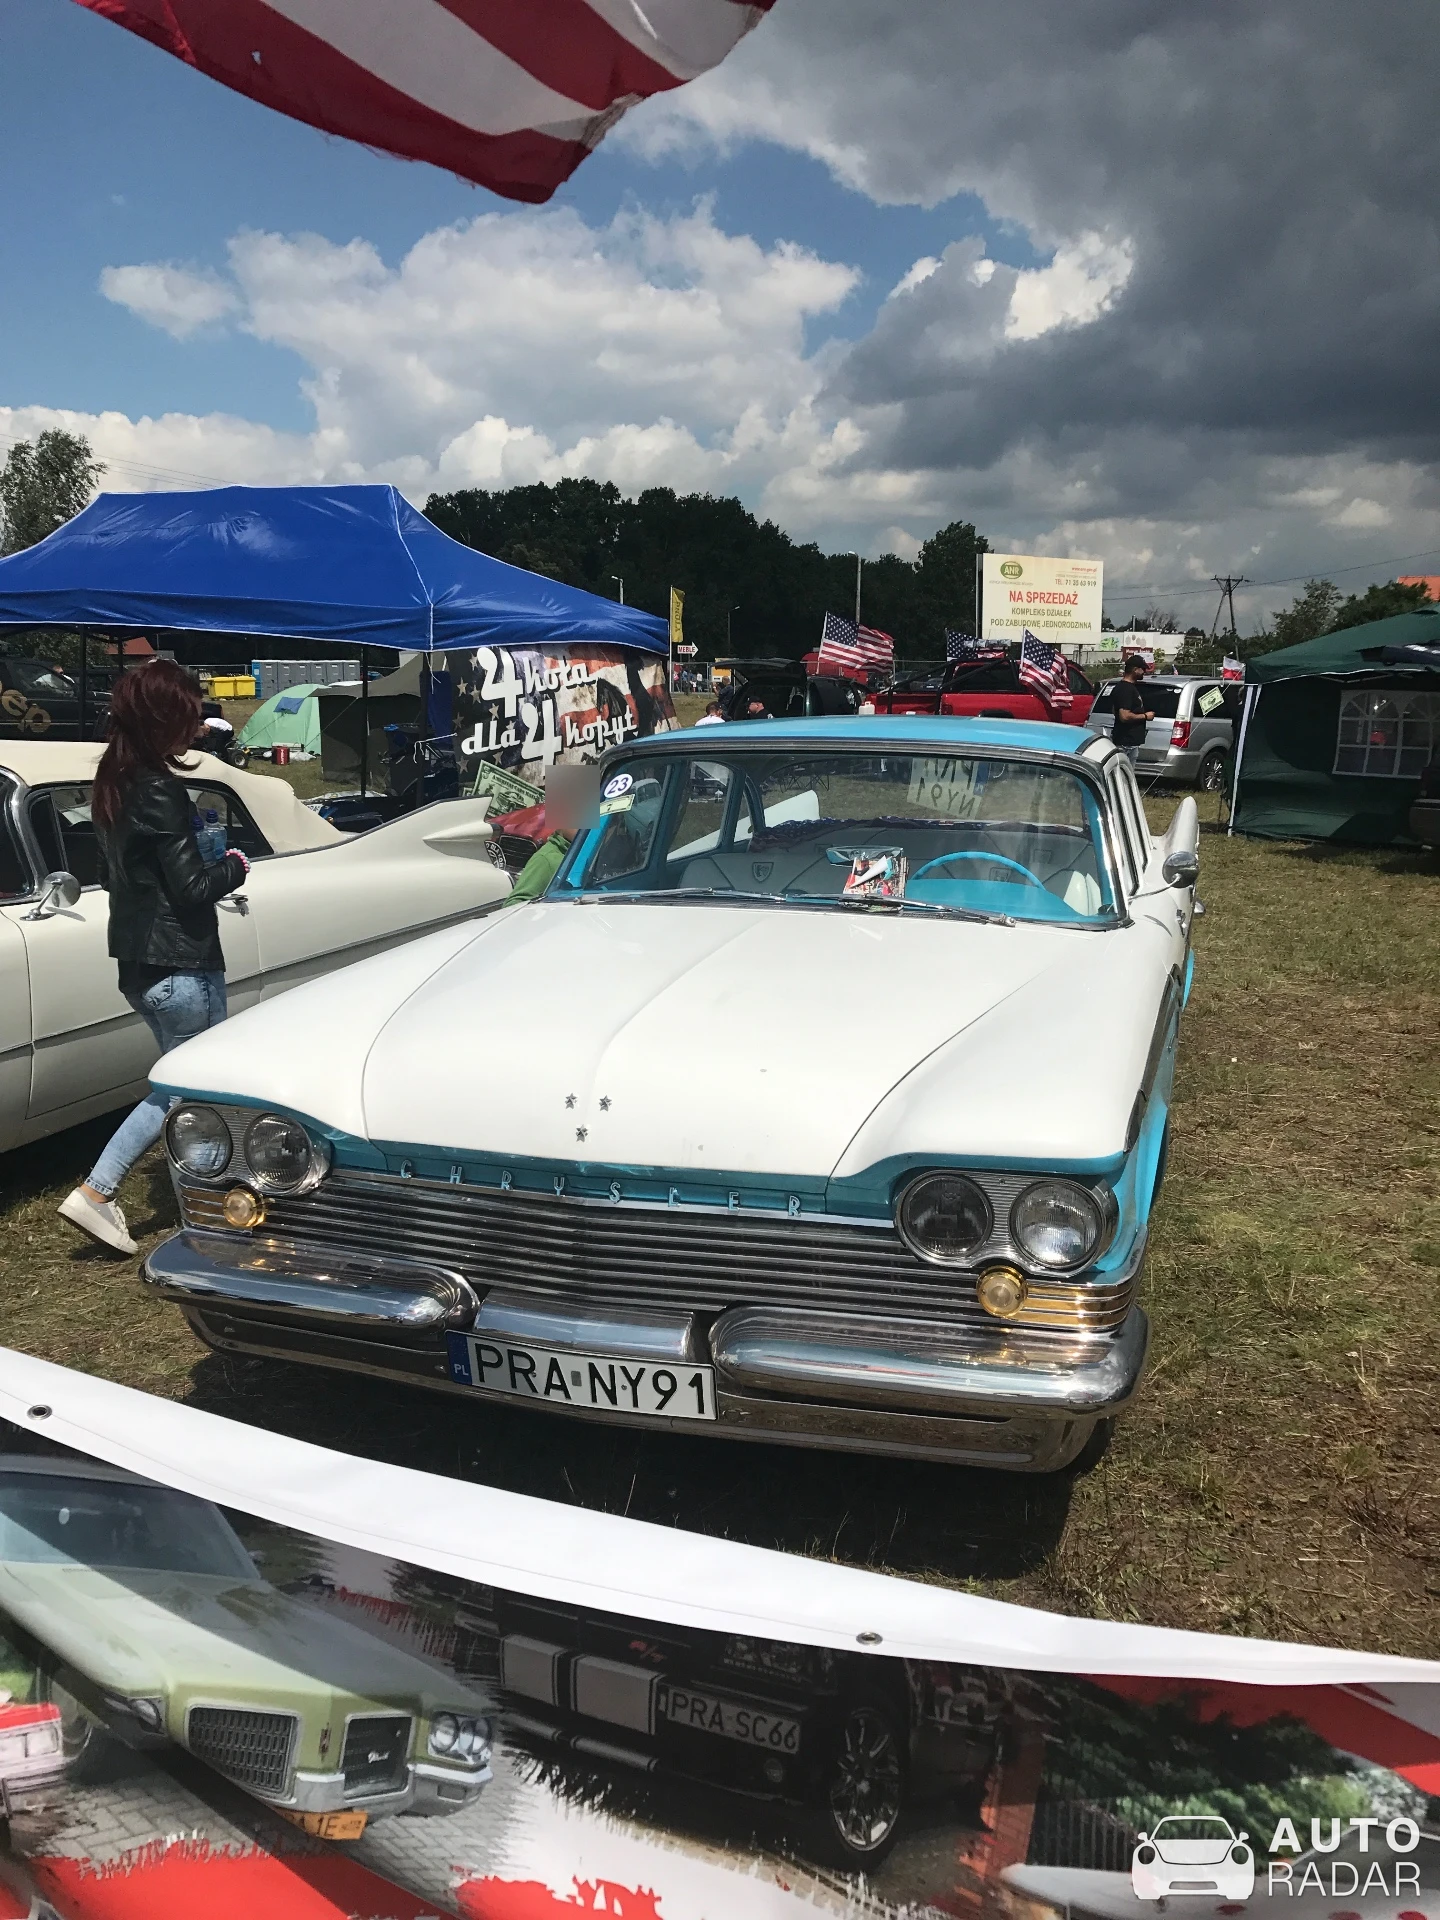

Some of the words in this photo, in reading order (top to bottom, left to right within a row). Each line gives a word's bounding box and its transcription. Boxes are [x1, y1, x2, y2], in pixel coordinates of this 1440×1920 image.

[1004, 564, 1019, 575] ANR
[1009, 590, 1023, 603] NA
[1026, 591, 1078, 605] SPRZEDAŻ
[1012, 607, 1045, 617] KOMPLEKS
[1047, 608, 1072, 617] DZIAŁEK
[991, 618, 1004, 627] POD
[1005, 619, 1040, 629] ZABUDOWĘ
[1042, 620, 1091, 630] JEDNORODZINNĄ
[477, 647, 523, 718] 4
[461, 719, 520, 755] dla
[521, 698, 562, 766] 4
[565, 704, 637, 747] kopyt
[607, 776, 629, 795] 23
[400, 1159, 801, 1217] CHRYSLER
[453, 1363, 469, 1377] PL
[475, 1343, 572, 1401] PRA
[588, 1361, 706, 1415] NY91
[671, 1692, 724, 1732] PRA
[735, 1711, 797, 1750] SC66
